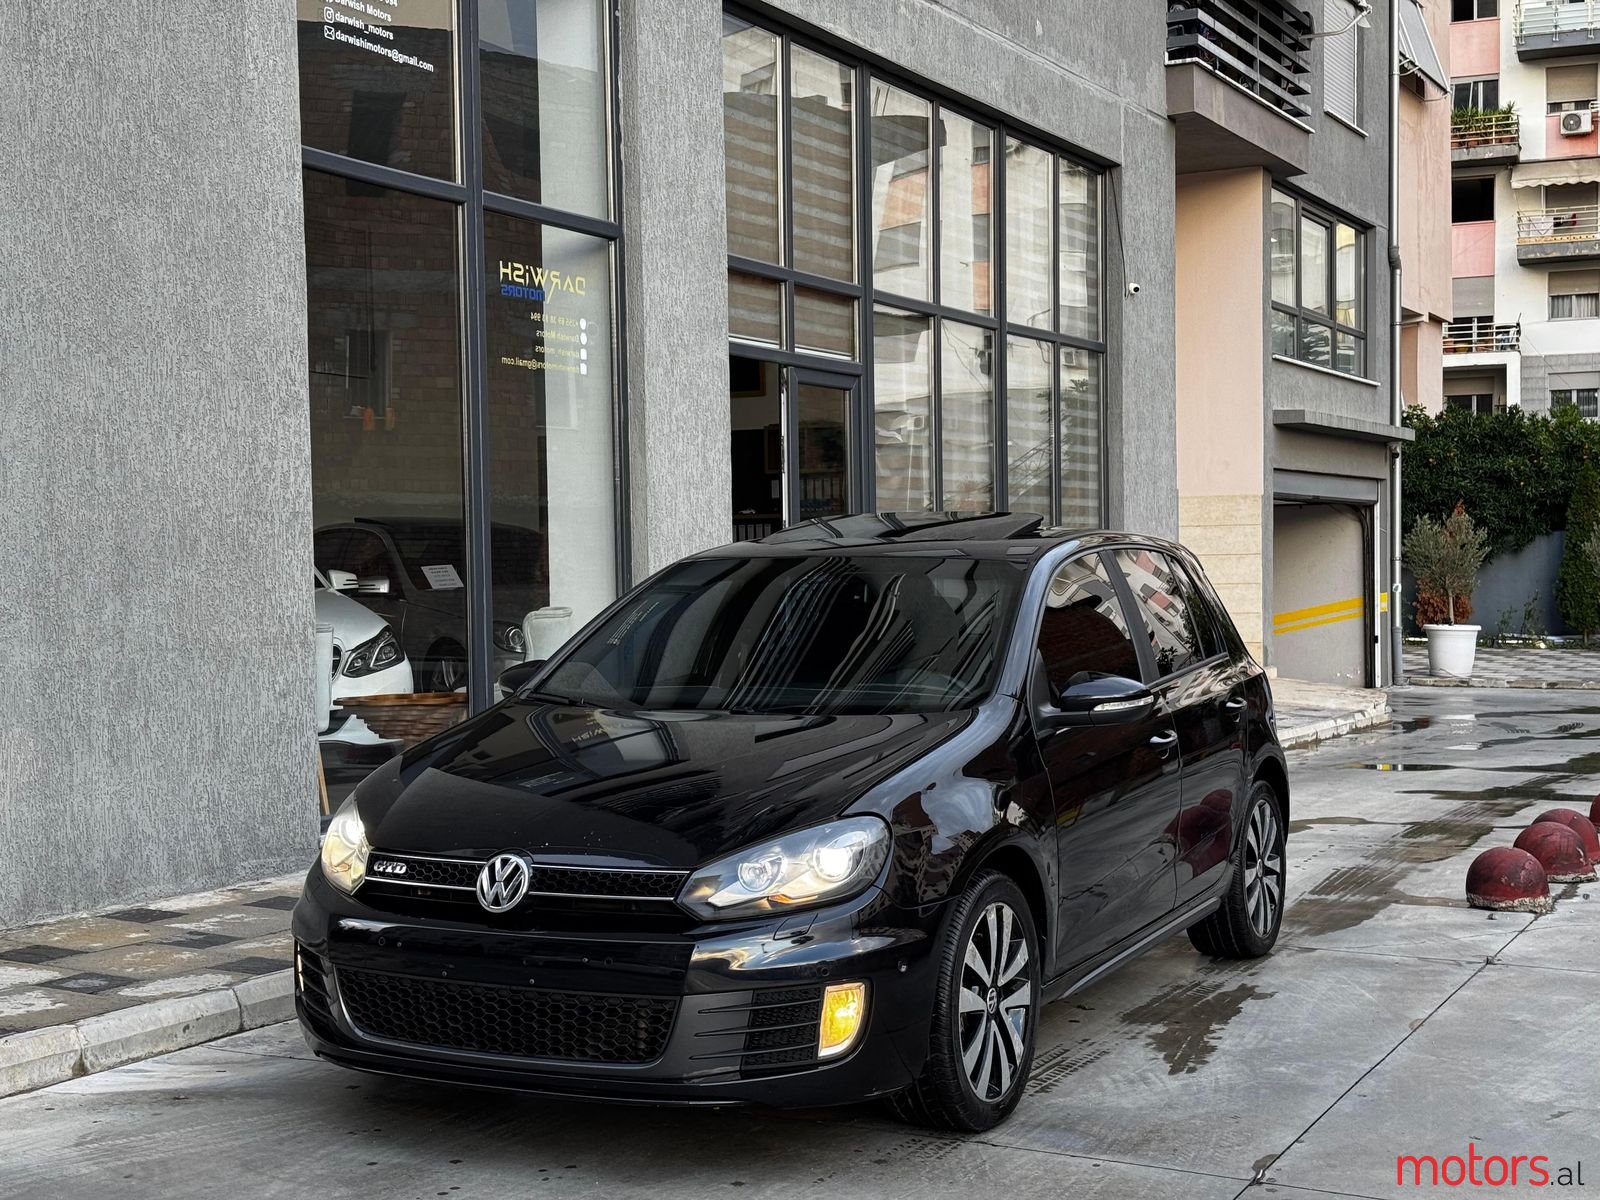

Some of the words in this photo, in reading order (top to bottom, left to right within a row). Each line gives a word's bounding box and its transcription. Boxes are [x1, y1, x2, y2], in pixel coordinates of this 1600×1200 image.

[366, 4, 392, 22] Motors
[335, 11, 394, 40] darwish_motors
[335, 30, 434, 72] darwishimotors@gmail.com
[373, 860, 407, 875] GTD
